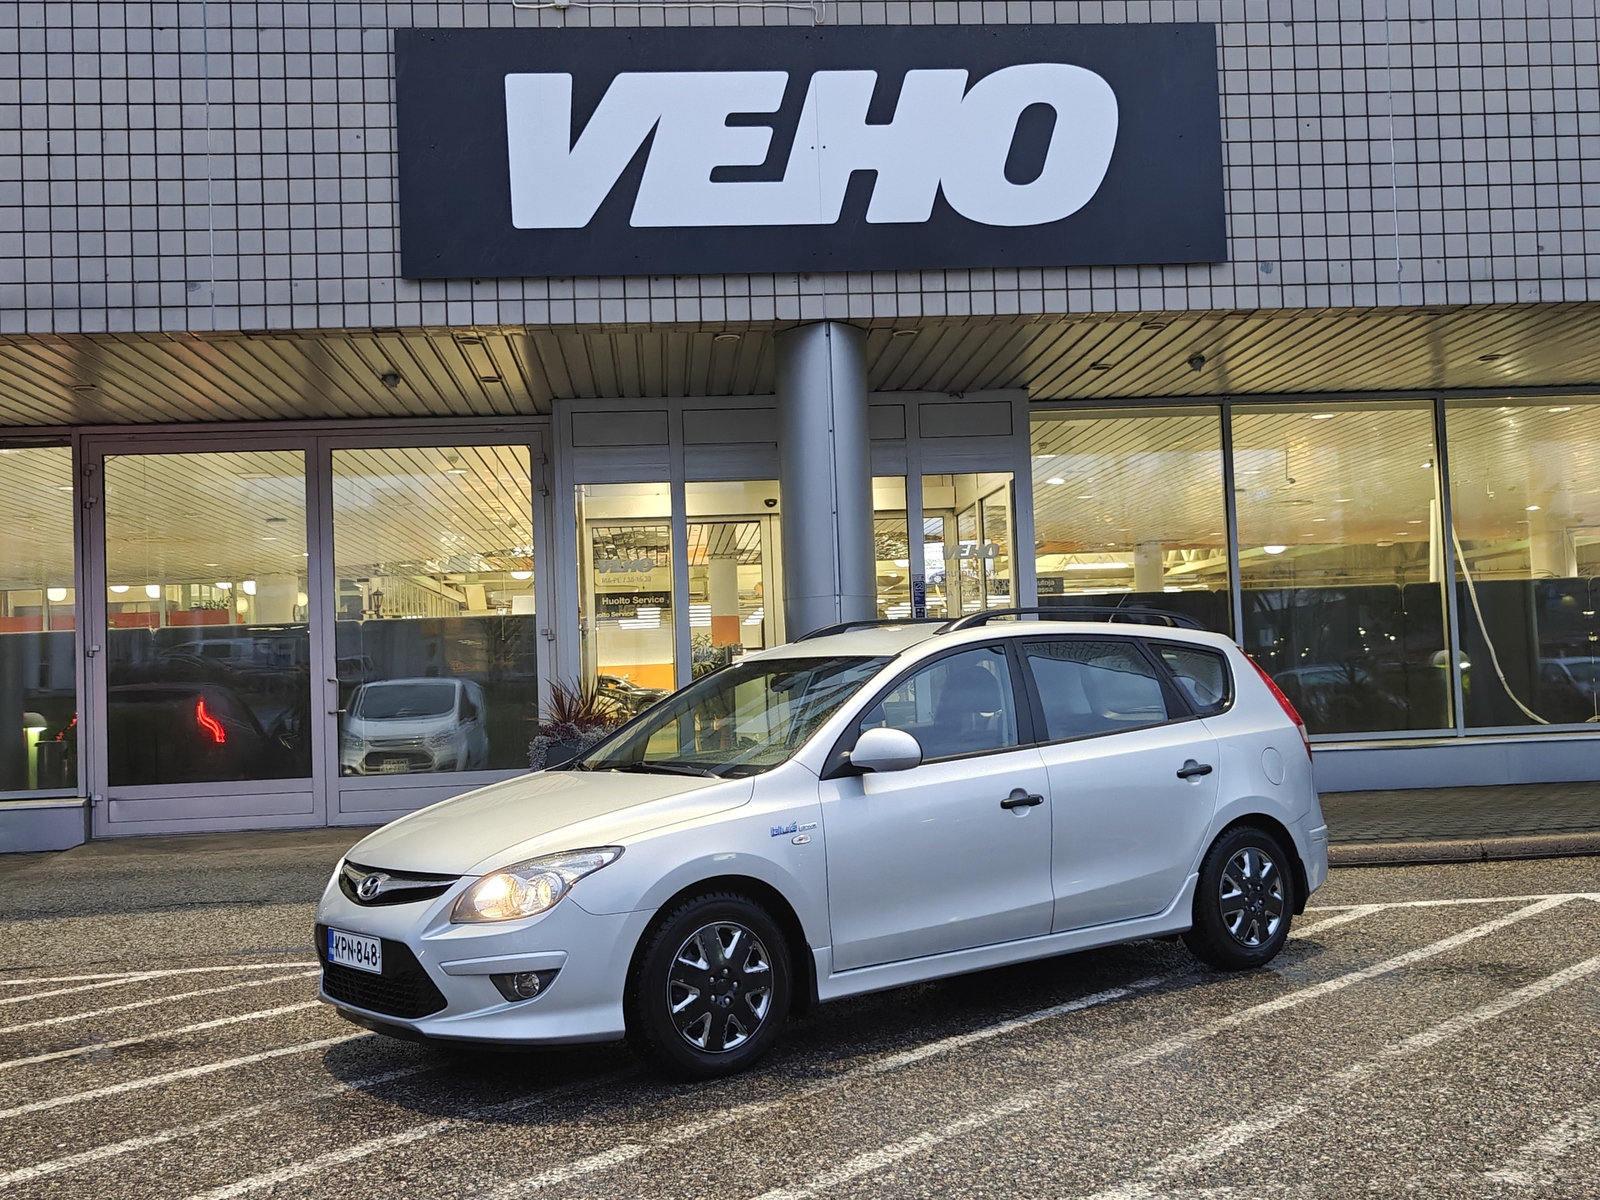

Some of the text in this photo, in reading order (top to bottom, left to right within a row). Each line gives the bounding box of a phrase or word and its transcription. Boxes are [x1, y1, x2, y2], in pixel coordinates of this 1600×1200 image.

[504, 62, 1119, 229] VEHO
[943, 544, 999, 559] VEHO
[602, 595, 664, 605] Huolto Service
[770, 821, 797, 837] blue
[335, 935, 377, 967] KPN-848
